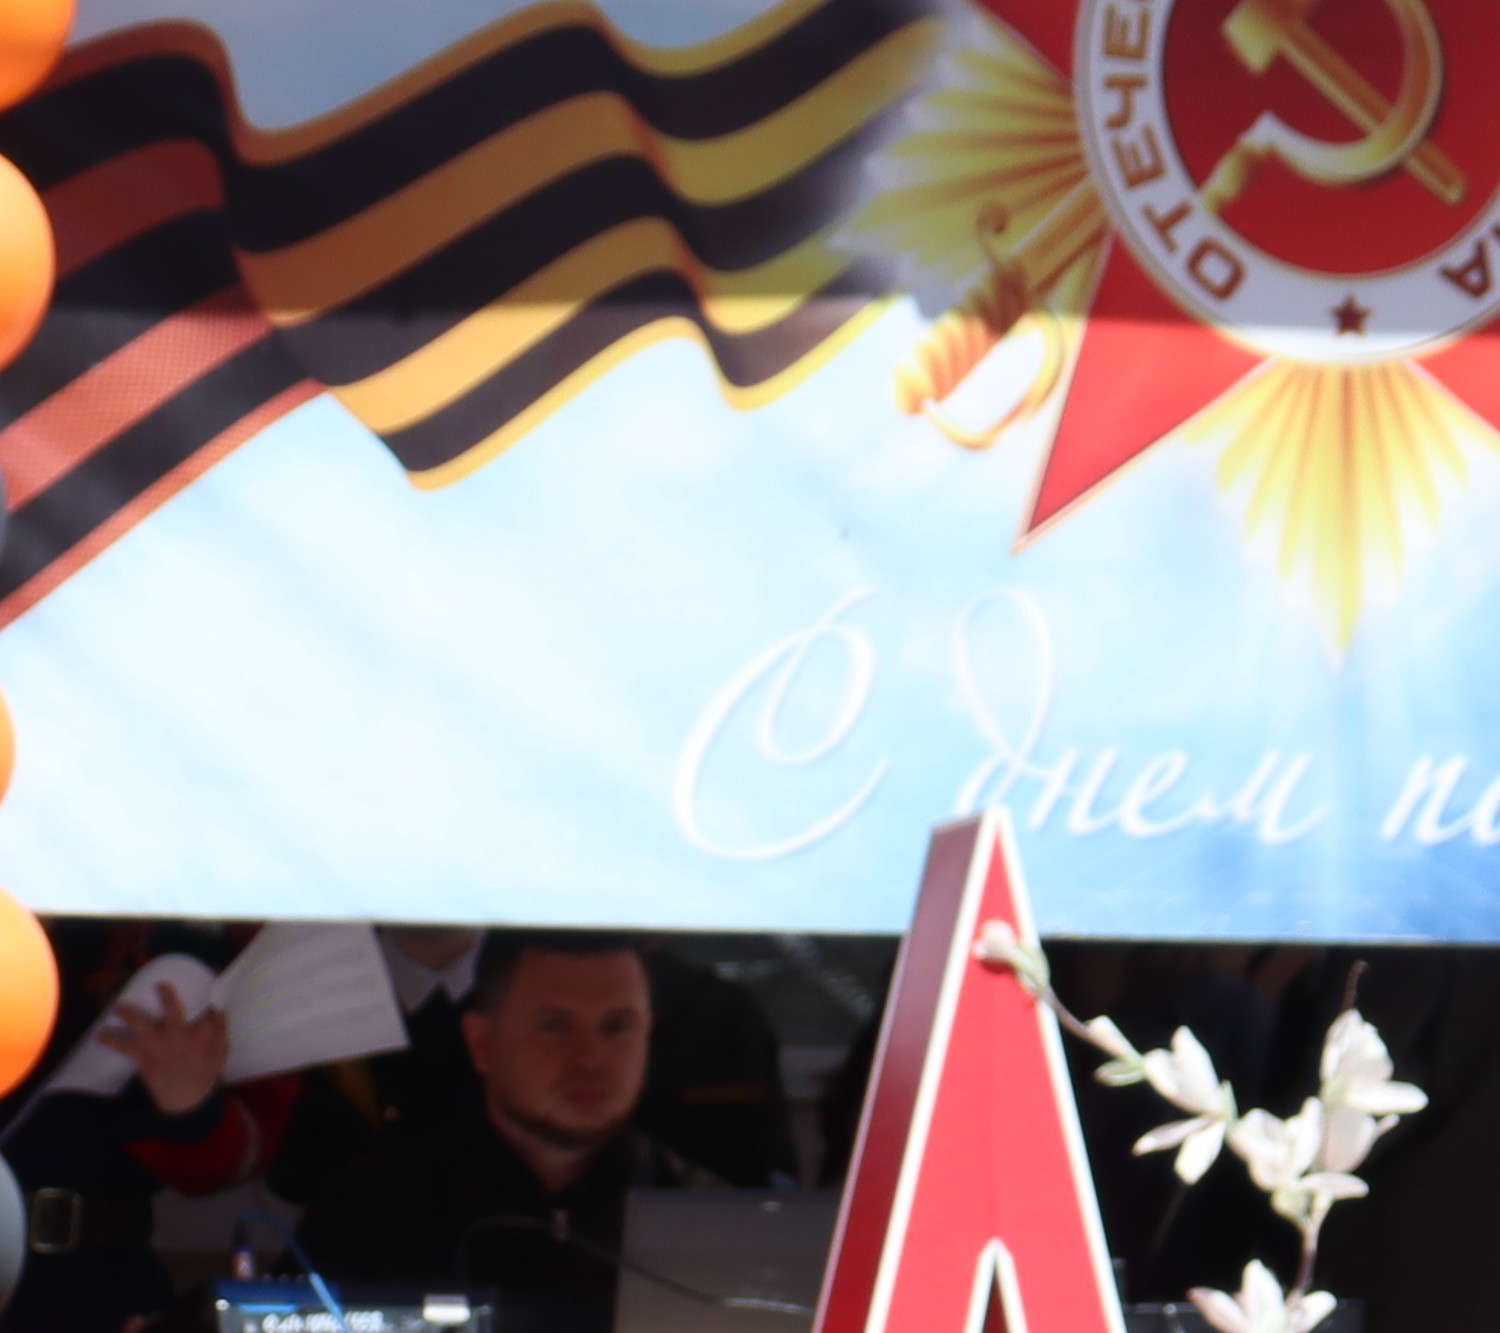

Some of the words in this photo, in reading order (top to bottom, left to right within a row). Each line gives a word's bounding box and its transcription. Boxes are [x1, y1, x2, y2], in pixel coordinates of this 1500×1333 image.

[1101, 0, 1249, 302] ОТЕЧЕ
[672, 584, 891, 860] С
[953, 589, 1330, 845] днем
